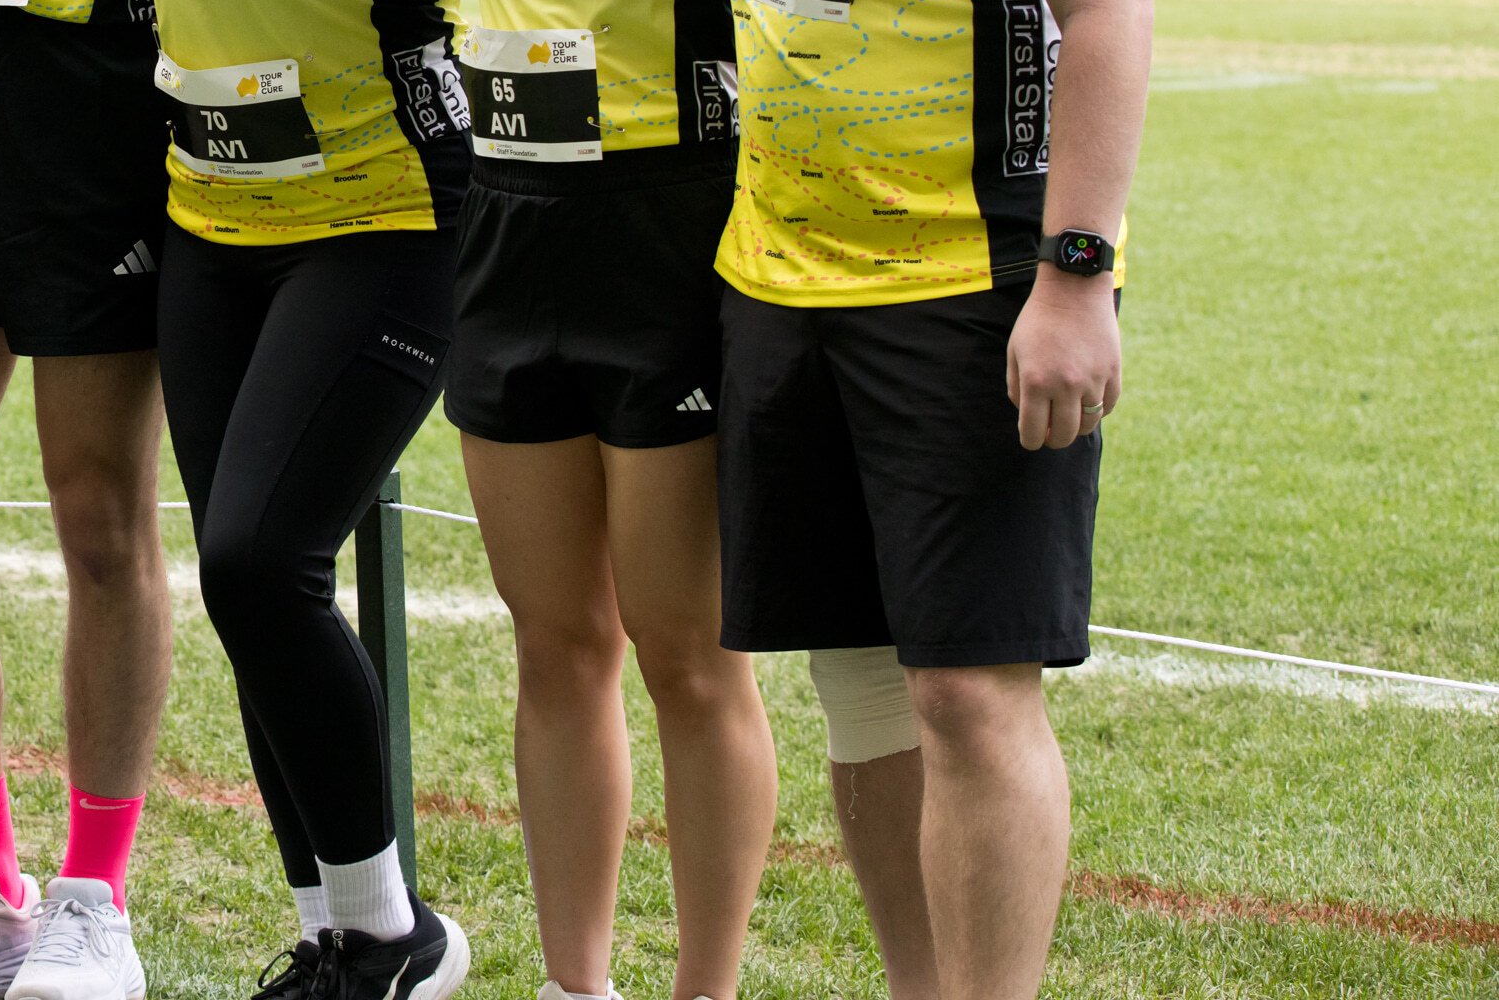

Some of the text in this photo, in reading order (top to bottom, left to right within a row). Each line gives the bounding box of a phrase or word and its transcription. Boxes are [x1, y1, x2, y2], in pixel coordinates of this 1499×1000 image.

[552, 41, 577, 49] TOUR
[1012, 4, 1038, 77] First
[553, 55, 578, 64] CURE
[788, 51, 821, 60] Melbourne
[161, 67, 172, 81] can
[260, 72, 283, 81] TOUR
[261, 85, 283, 95] CURE
[491, 77, 516, 103] 65
[200, 110, 228, 132] 70
[491, 112, 527, 137] AV1
[207, 139, 248, 159] AV1
[496, 147, 538, 157] Staff Foundation
[334, 173, 368, 184] Brooklyn
[801, 169, 823, 179] Bowral
[872, 208, 908, 217] Brooklyn
[214, 225, 240, 234] Goulburn
[329, 220, 354, 229] Hawks
[381, 335, 435, 366] ROCKWEAR
